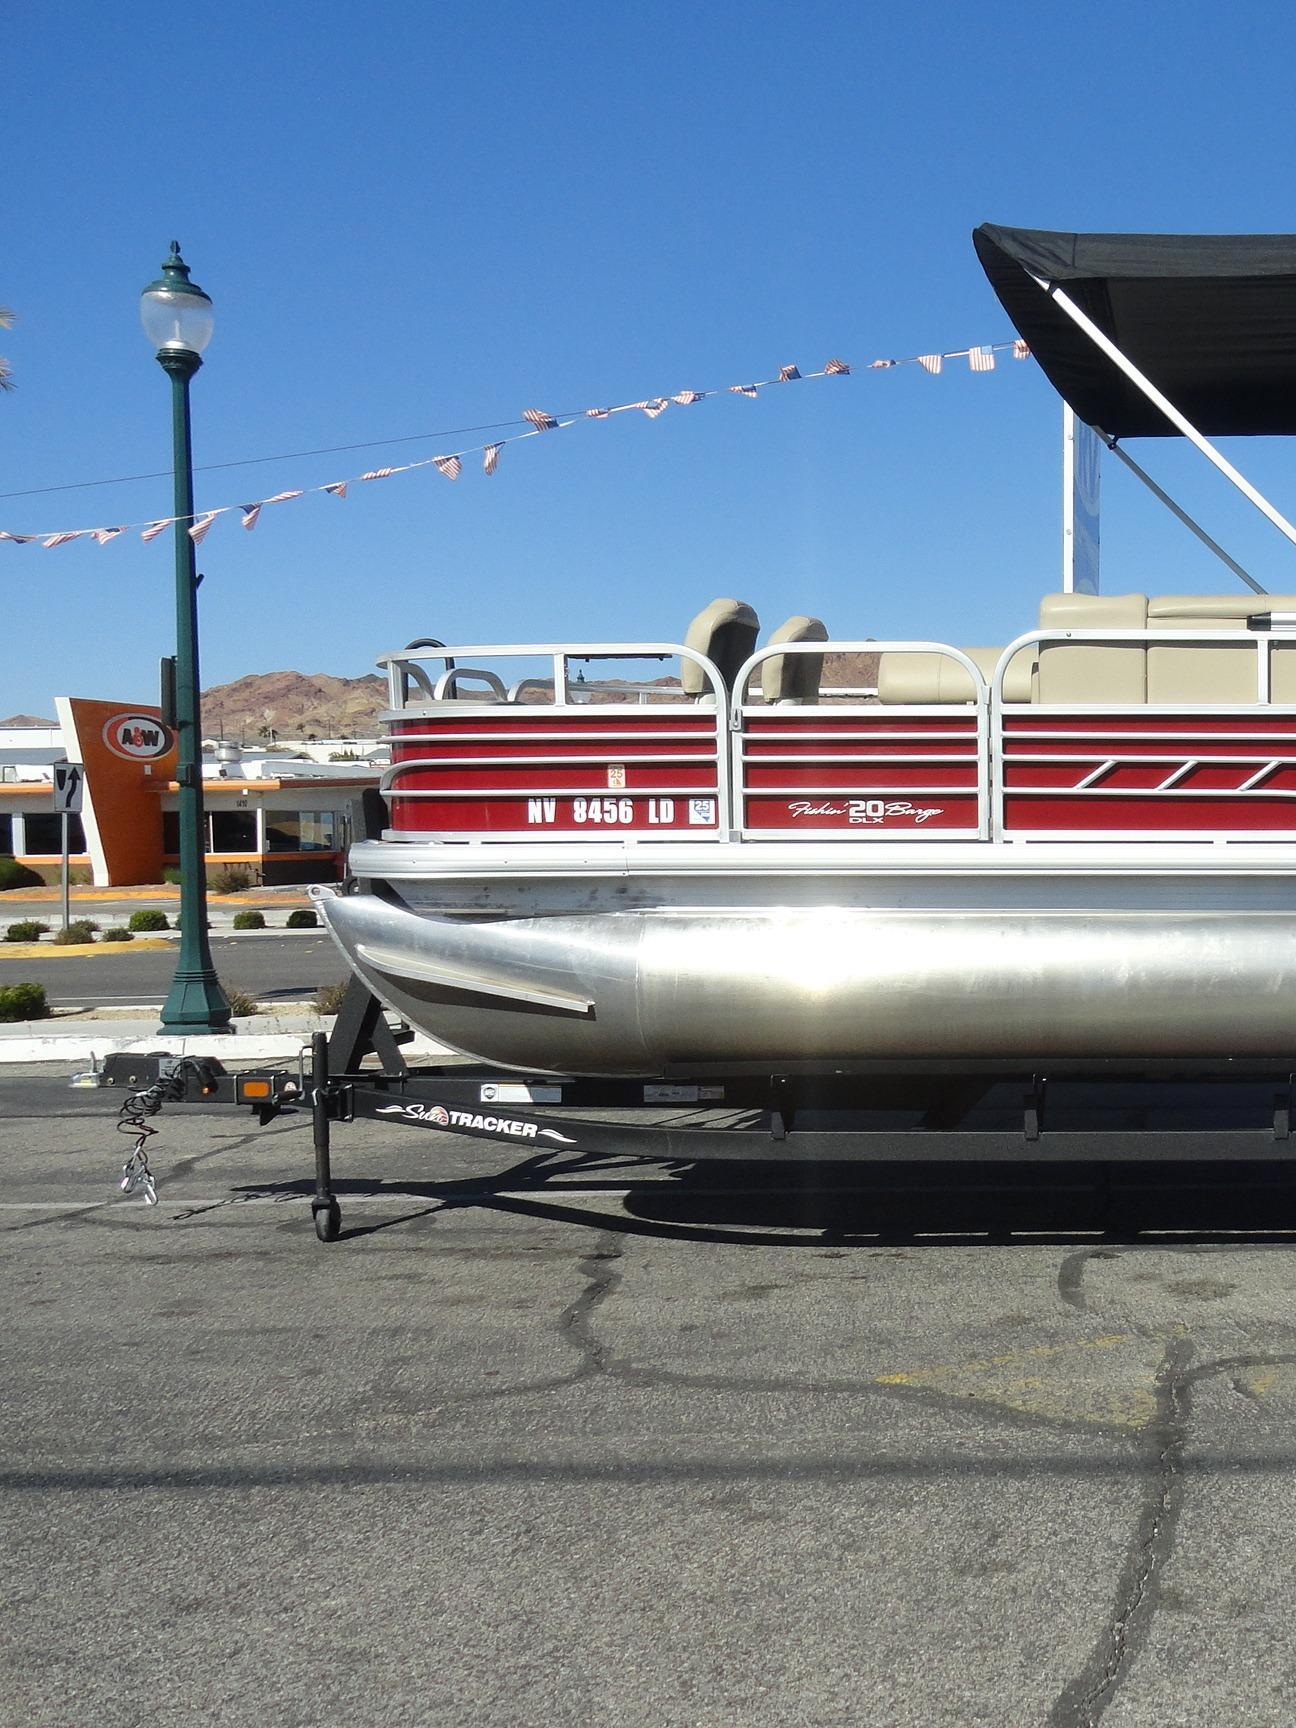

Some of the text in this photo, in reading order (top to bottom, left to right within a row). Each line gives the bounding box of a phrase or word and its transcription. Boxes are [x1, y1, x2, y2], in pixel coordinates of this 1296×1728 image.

[122, 727, 160, 748] A&W
[610, 769, 623, 779] 25
[528, 797, 674, 824] NV 8456 LD
[695, 800, 710, 811] 25
[788, 800, 944, 823] Fishin' 20 Barge
[402, 1104, 538, 1137] Sun TRACKER
